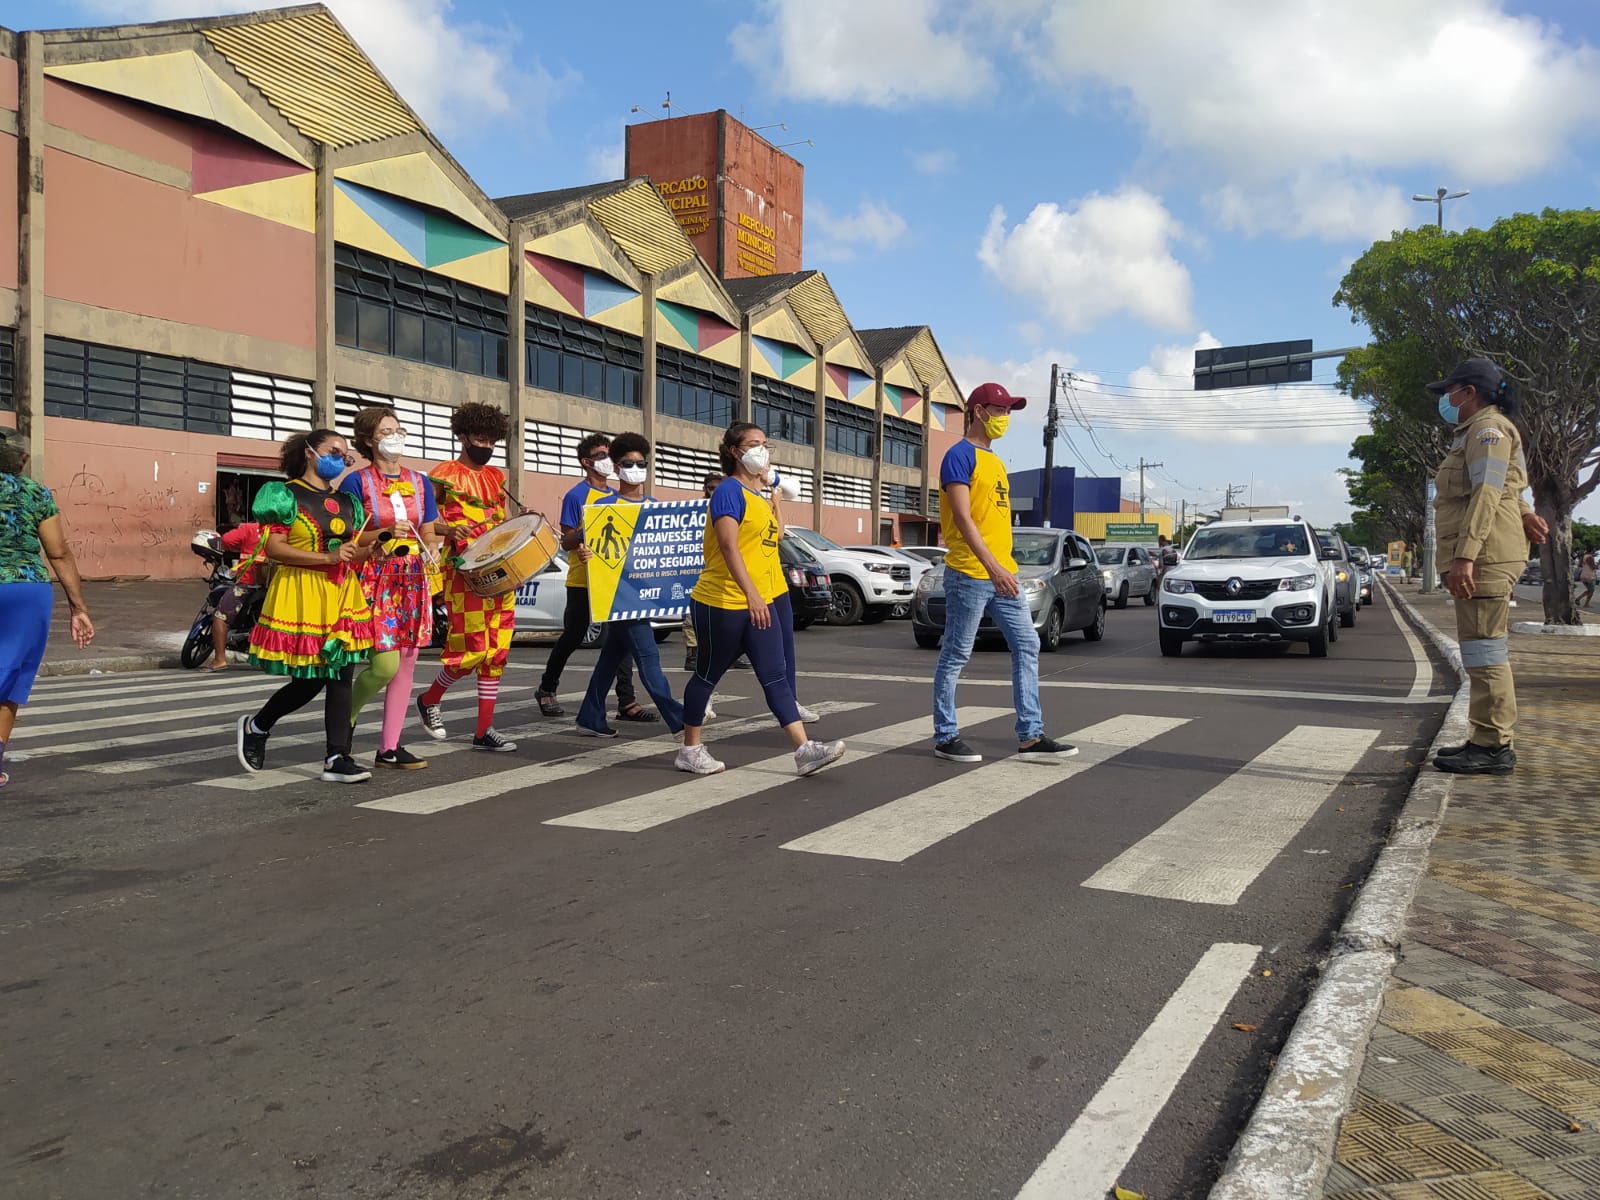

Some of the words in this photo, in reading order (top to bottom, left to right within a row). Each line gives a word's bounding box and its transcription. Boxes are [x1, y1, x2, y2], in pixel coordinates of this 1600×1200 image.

[739, 212, 776, 241] MERCADO
[737, 228, 776, 258] MUNICIPAL
[644, 511, 707, 531] ATENÇÃO
[634, 530, 693, 544] ATRAVESSE
[633, 546, 661, 556] FAIXA
[663, 545, 675, 555] DE
[633, 559, 657, 570] COM
[639, 588, 661, 599] SMTT
